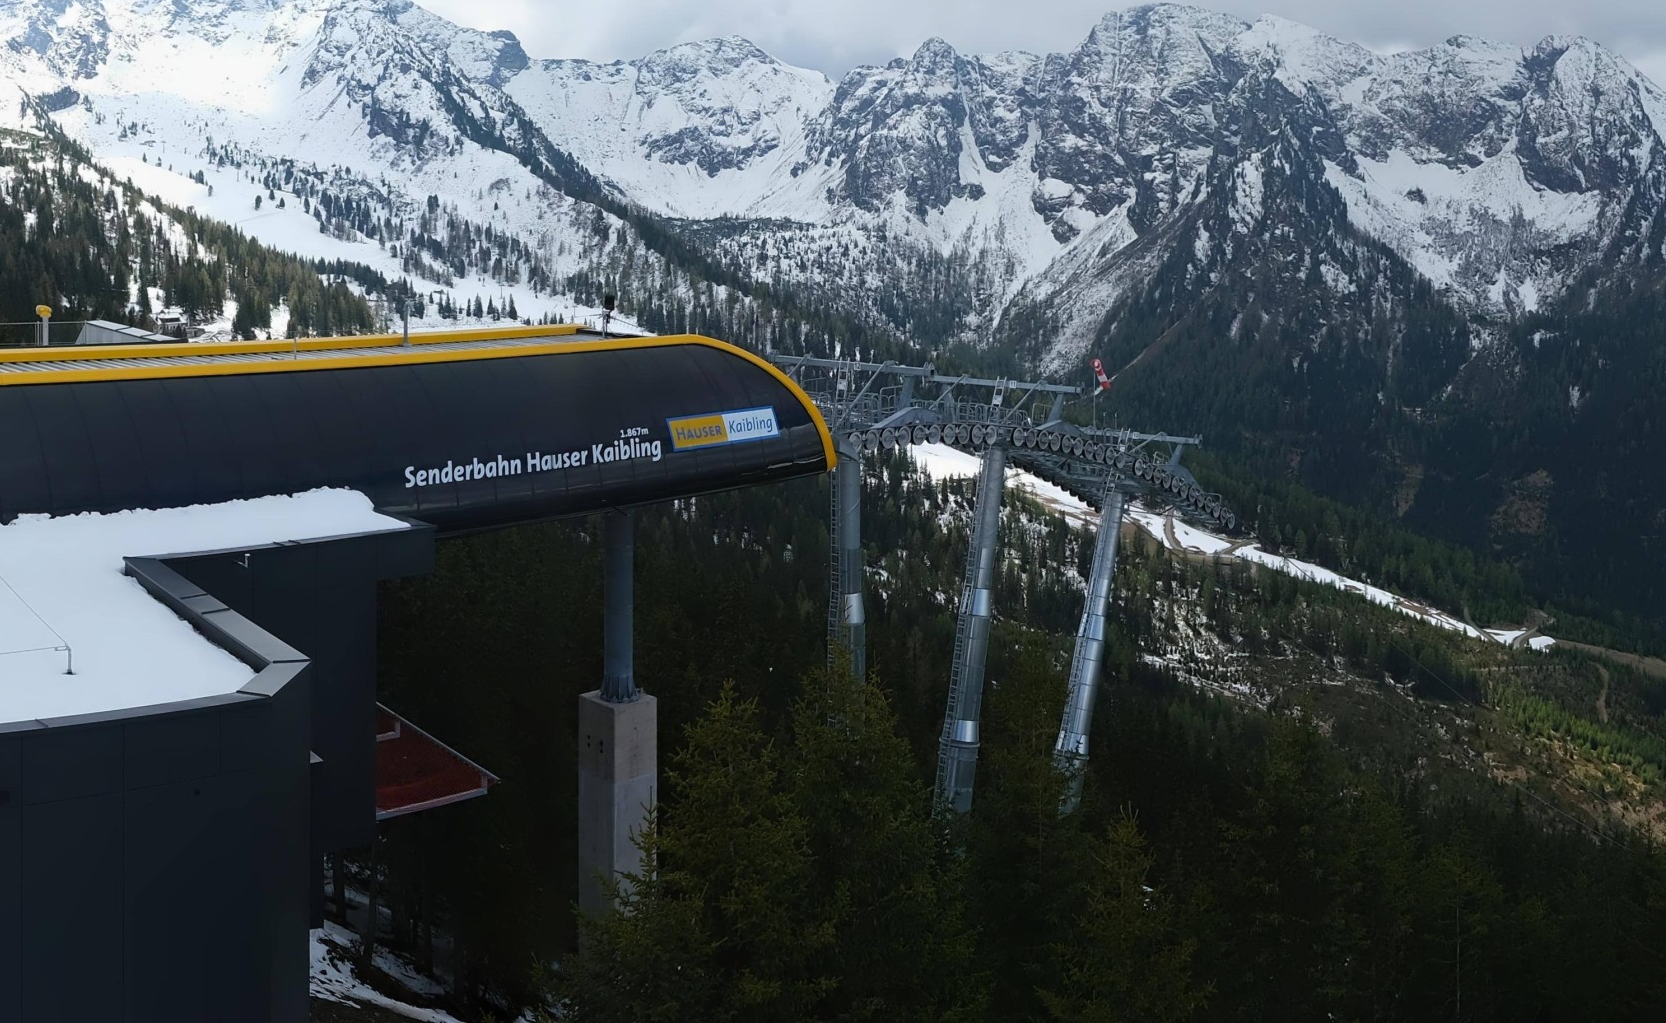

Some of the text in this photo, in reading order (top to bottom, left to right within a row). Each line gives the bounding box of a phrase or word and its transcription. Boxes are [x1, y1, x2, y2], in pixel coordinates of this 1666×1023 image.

[620, 427, 649, 438] 1.867m
[729, 416, 773, 434] Kaibling
[404, 438, 662, 488] Senderbahn Hauser Kaibling
